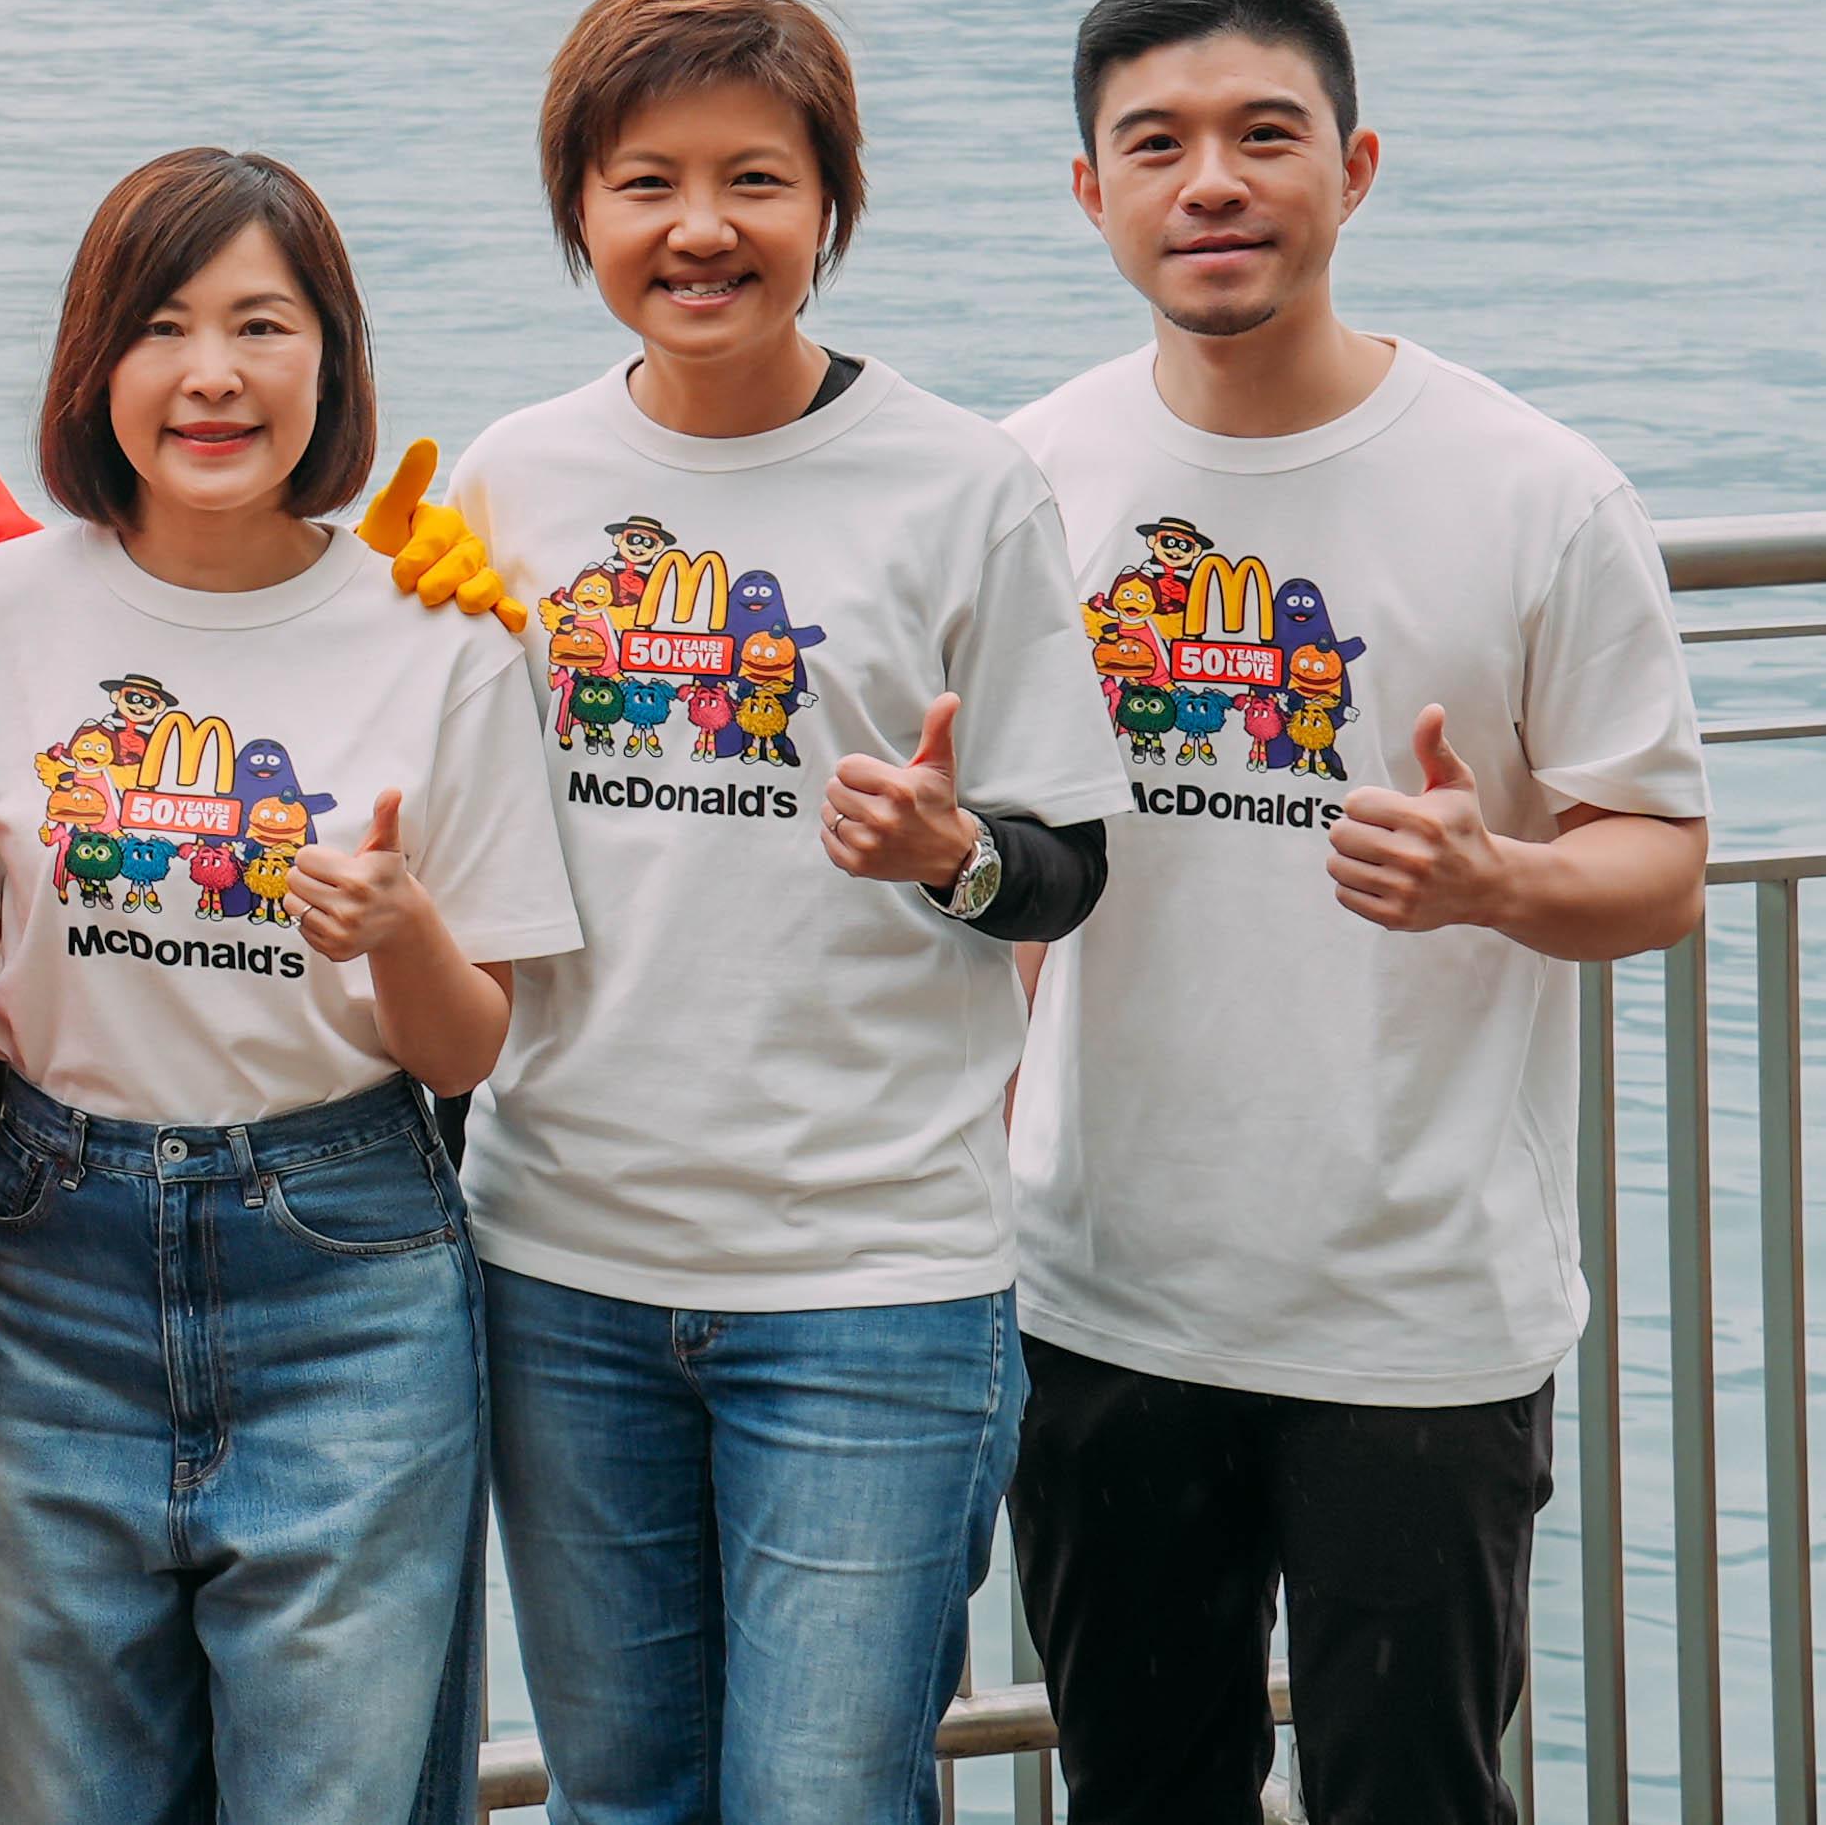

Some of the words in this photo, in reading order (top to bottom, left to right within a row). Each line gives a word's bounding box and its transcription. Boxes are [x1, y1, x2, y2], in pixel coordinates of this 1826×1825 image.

[628, 636, 671, 667] 50
[1180, 646, 1225, 676] 50
[568, 771, 798, 818] McDonald's
[129, 796, 175, 825] 50
[67, 925, 305, 978] McDonald's
